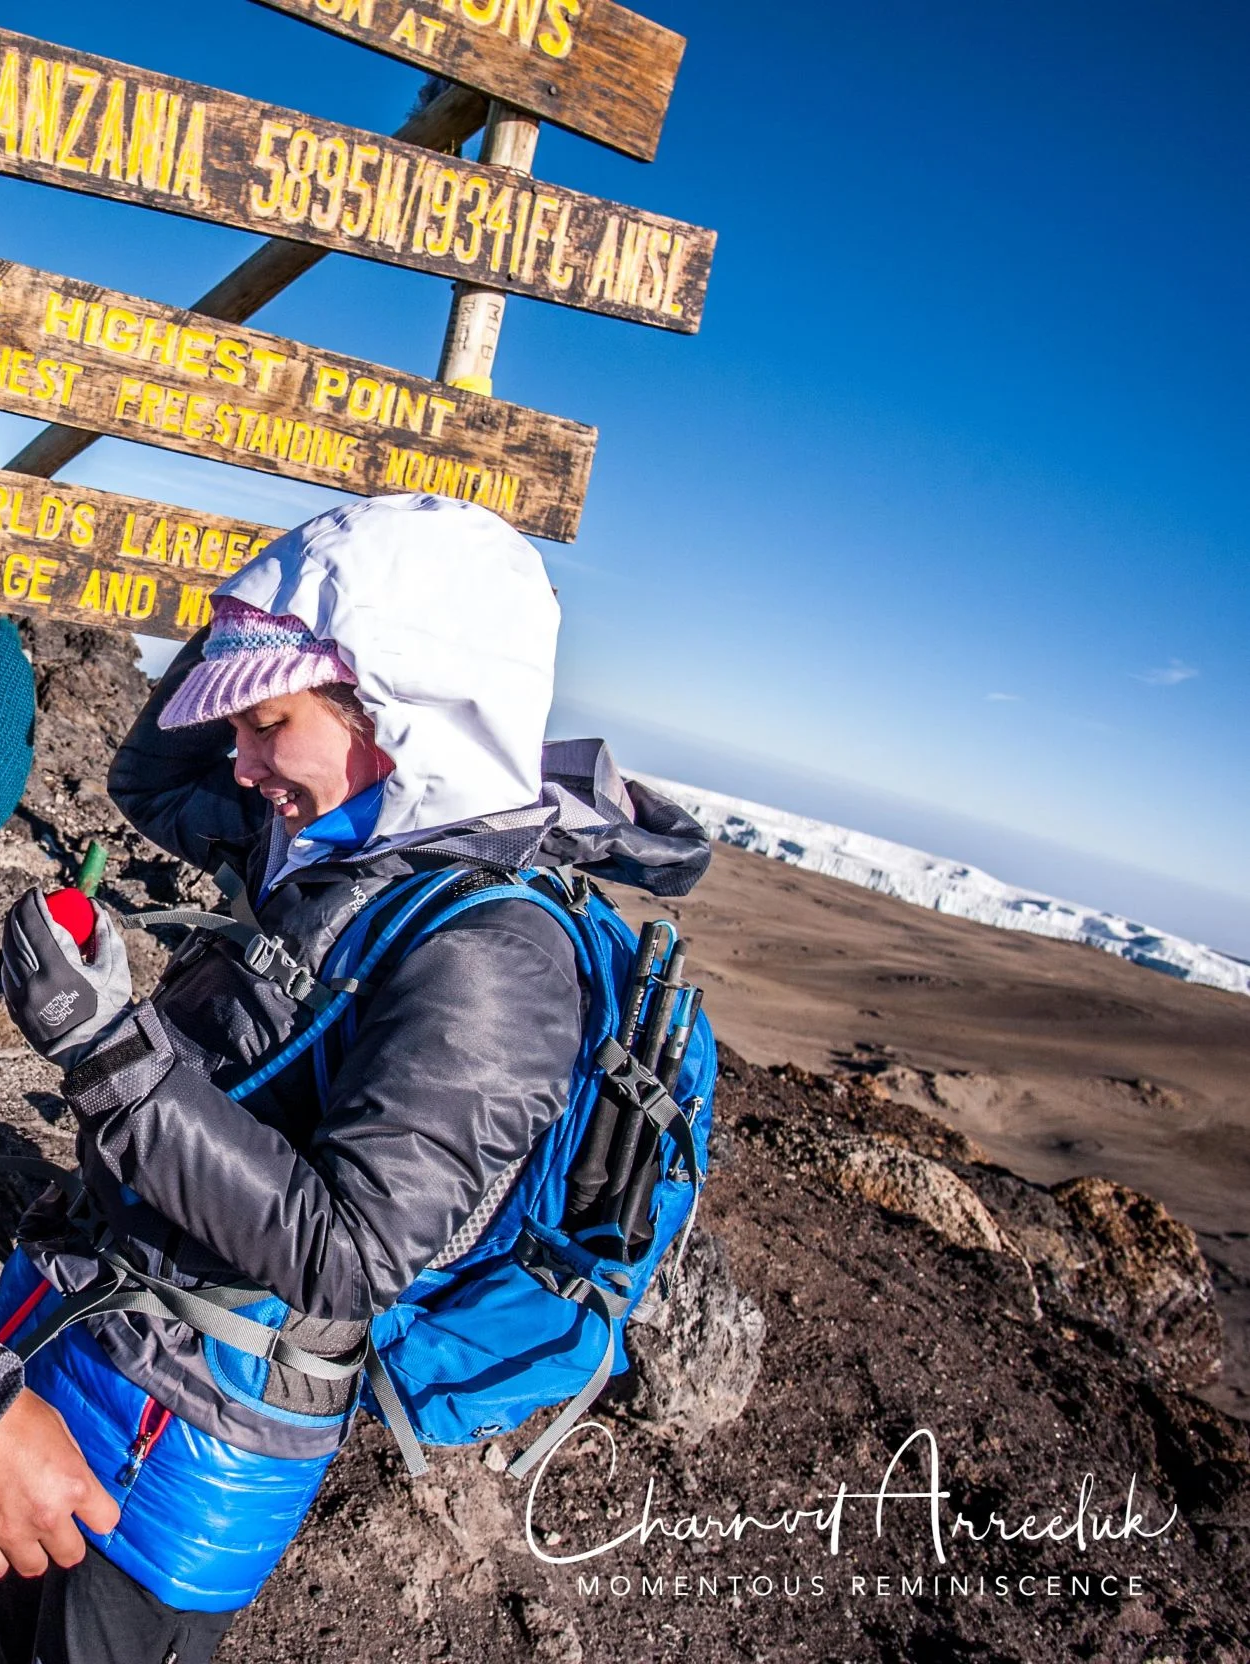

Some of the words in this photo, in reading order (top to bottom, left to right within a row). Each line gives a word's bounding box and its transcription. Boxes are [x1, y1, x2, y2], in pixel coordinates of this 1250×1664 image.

[390, 8, 446, 54] AT
[586, 214, 686, 318] AMSL
[43, 291, 287, 394] HIGHEST
[311, 364, 457, 438] POINT
[384, 446, 521, 514] MOUNTAIN
[77, 568, 157, 621] AND
